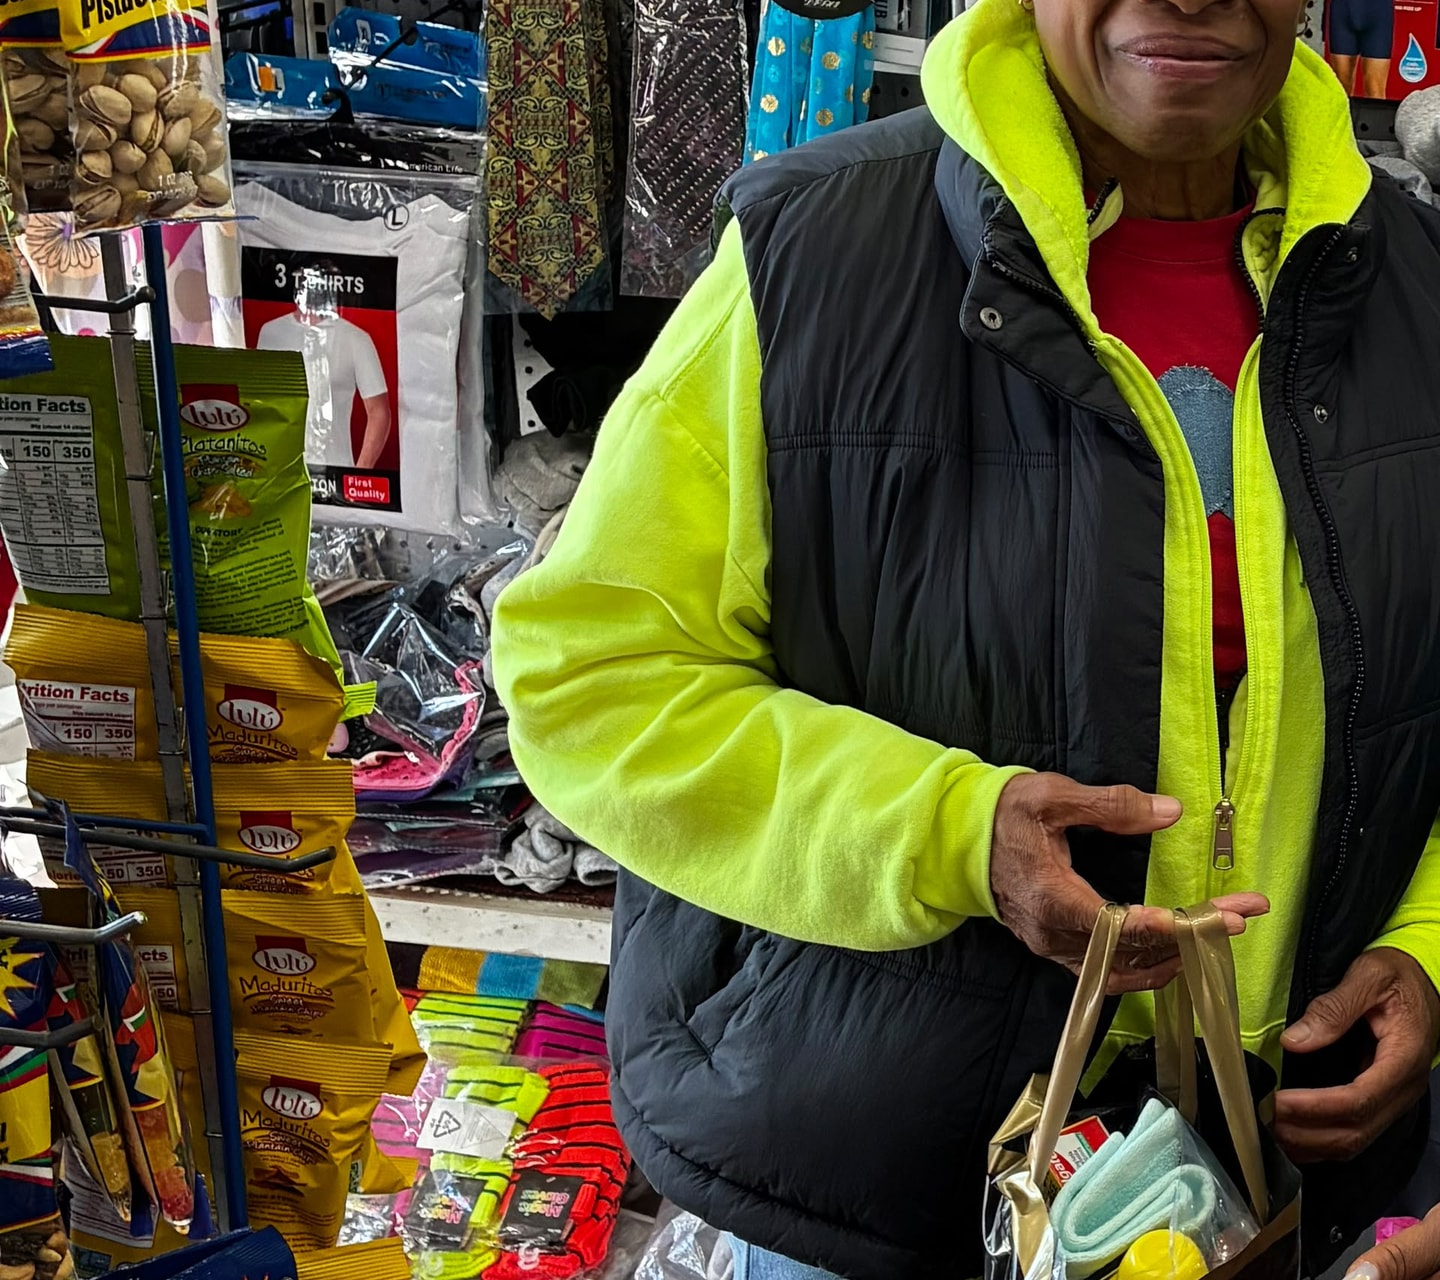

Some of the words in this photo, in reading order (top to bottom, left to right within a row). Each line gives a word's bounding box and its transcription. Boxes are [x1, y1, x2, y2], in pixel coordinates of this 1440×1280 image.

[392, 208, 403, 226] L
[275, 263, 287, 288] 3
[37, 398, 87, 414] Facts
[23, 445, 50, 459] 150
[63, 446, 91, 459] 350
[348, 476, 372, 488] First
[348, 487, 386, 501] Quality
[80, 687, 129, 703] Facts
[64, 727, 92, 740] 150
[105, 727, 132, 740] 350
[207, 725, 297, 756] Maduritos
[136, 865, 163, 877] 350
[240, 976, 333, 997] Maduritos
[243, 1109, 330, 1146] Maduritos
